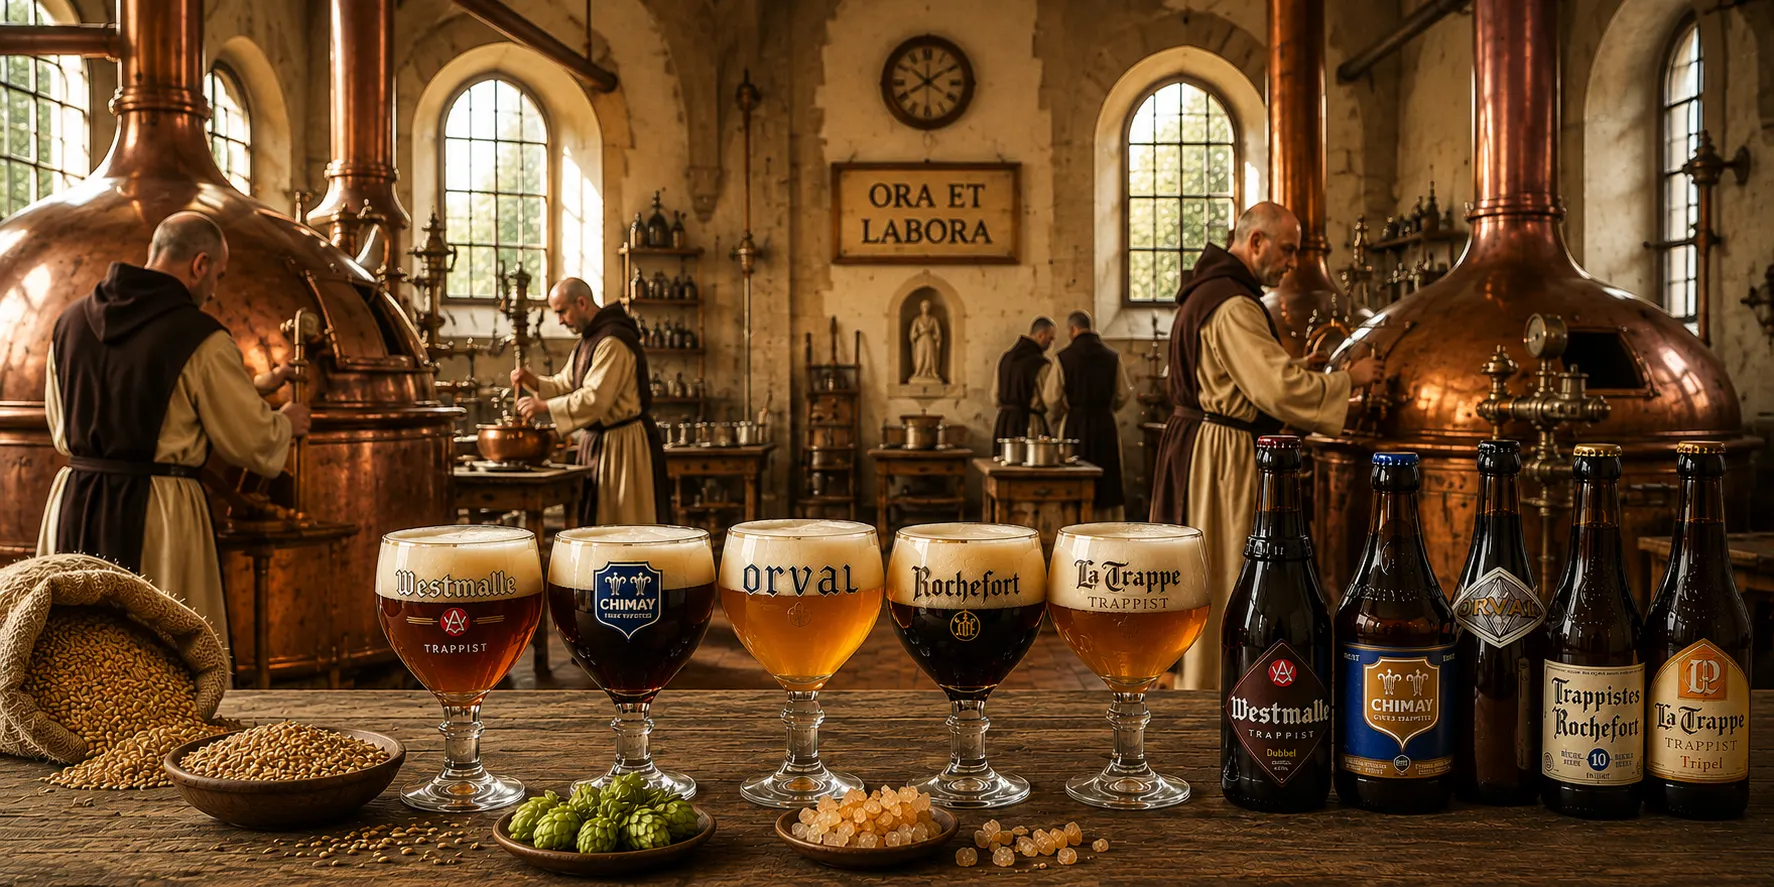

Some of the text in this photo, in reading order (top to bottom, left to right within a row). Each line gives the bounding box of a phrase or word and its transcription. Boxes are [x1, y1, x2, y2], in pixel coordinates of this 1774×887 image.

[868, 182, 986, 208] ORA ET
[861, 218, 993, 245] LABORA
[396, 569, 517, 599] Westmalle
[911, 565, 1021, 603] Rochefort
[1073, 560, 1181, 594] La Trappe
[599, 598, 656, 611] CHIMAY
[1087, 596, 1169, 610] TRAPPIST
[1457, 597, 1537, 619] ORVAL
[423, 642, 488, 654] TRAPPIST
[1371, 698, 1433, 713] CHIMAY
[1552, 677, 1640, 713] Trappistes
[1231, 696, 1330, 725] Westmalle
[1654, 702, 1745, 736] La Trappe
[1248, 729, 1315, 740] TRAPPIST
[1552, 706, 1640, 744] Rochefort
[1266, 748, 1297, 758] Dubbel
[1665, 737, 1738, 752] TRAPPIST
[1591, 752, 1607, 767] 10
[1680, 755, 1723, 773] Tripel
